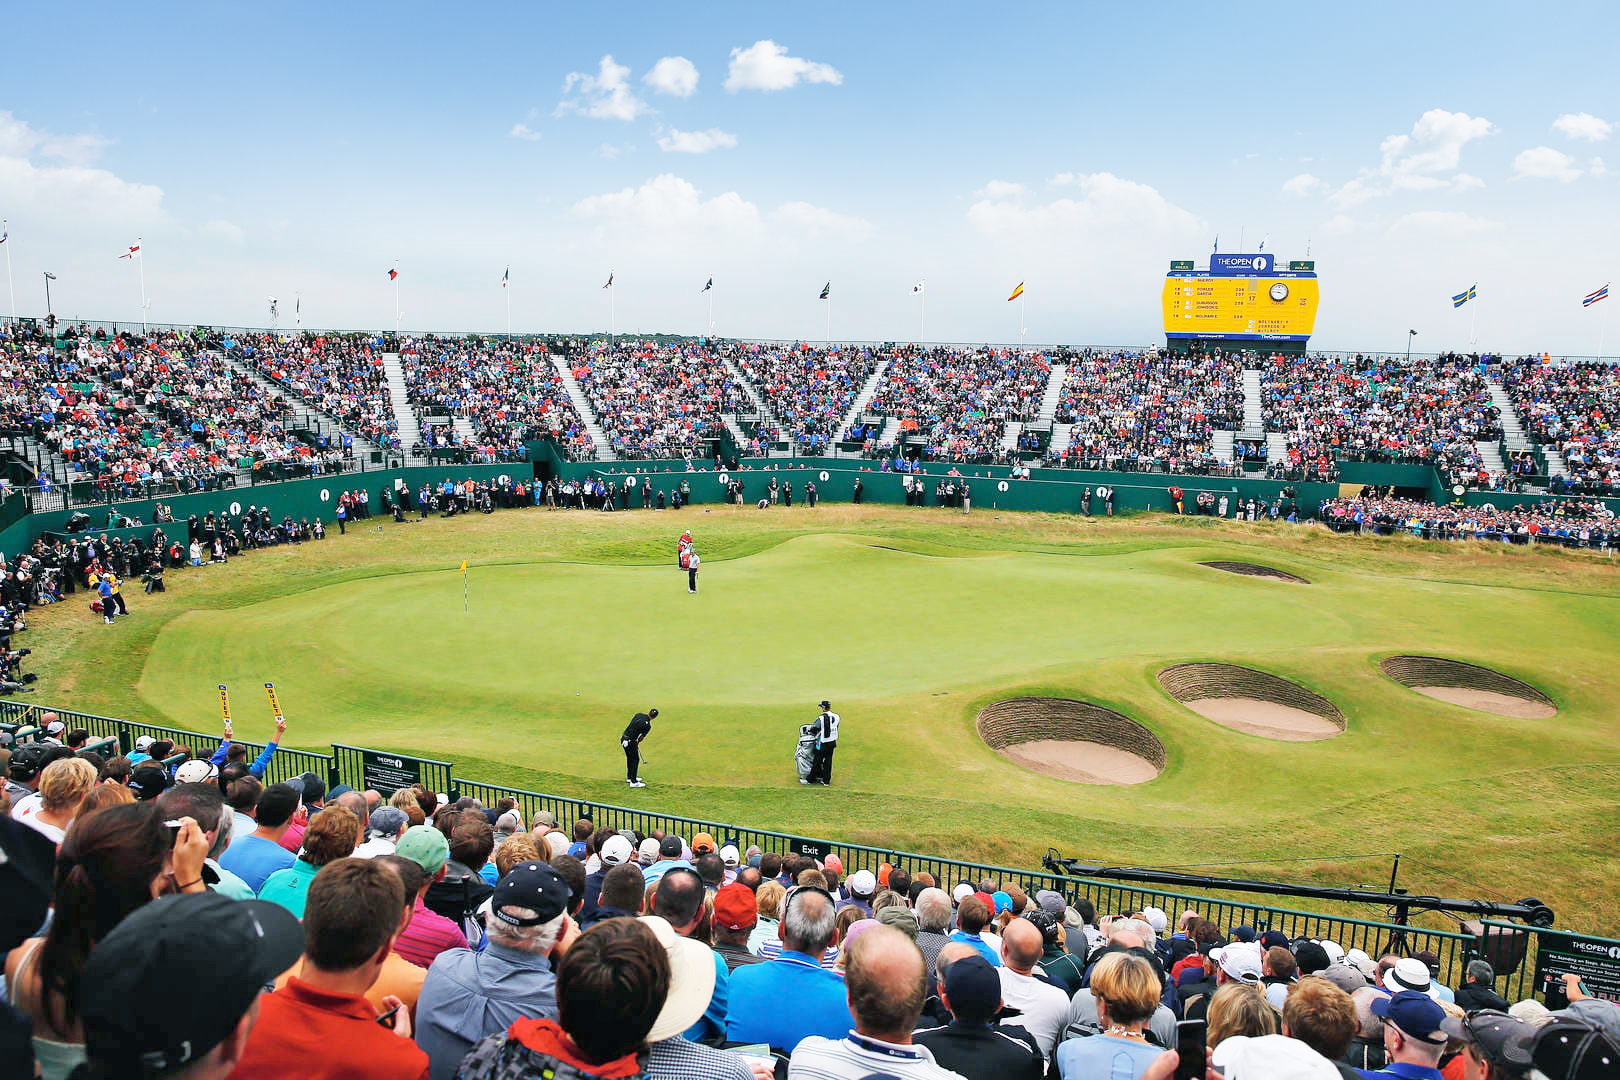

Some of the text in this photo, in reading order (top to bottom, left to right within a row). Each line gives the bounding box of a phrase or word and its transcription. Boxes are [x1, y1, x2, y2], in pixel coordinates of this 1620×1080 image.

[267, 688, 279, 714] QUIET
[802, 844, 819, 855] Exit
[1572, 941, 1586, 950] THE
[1586, 944, 1608, 952] OPEN
